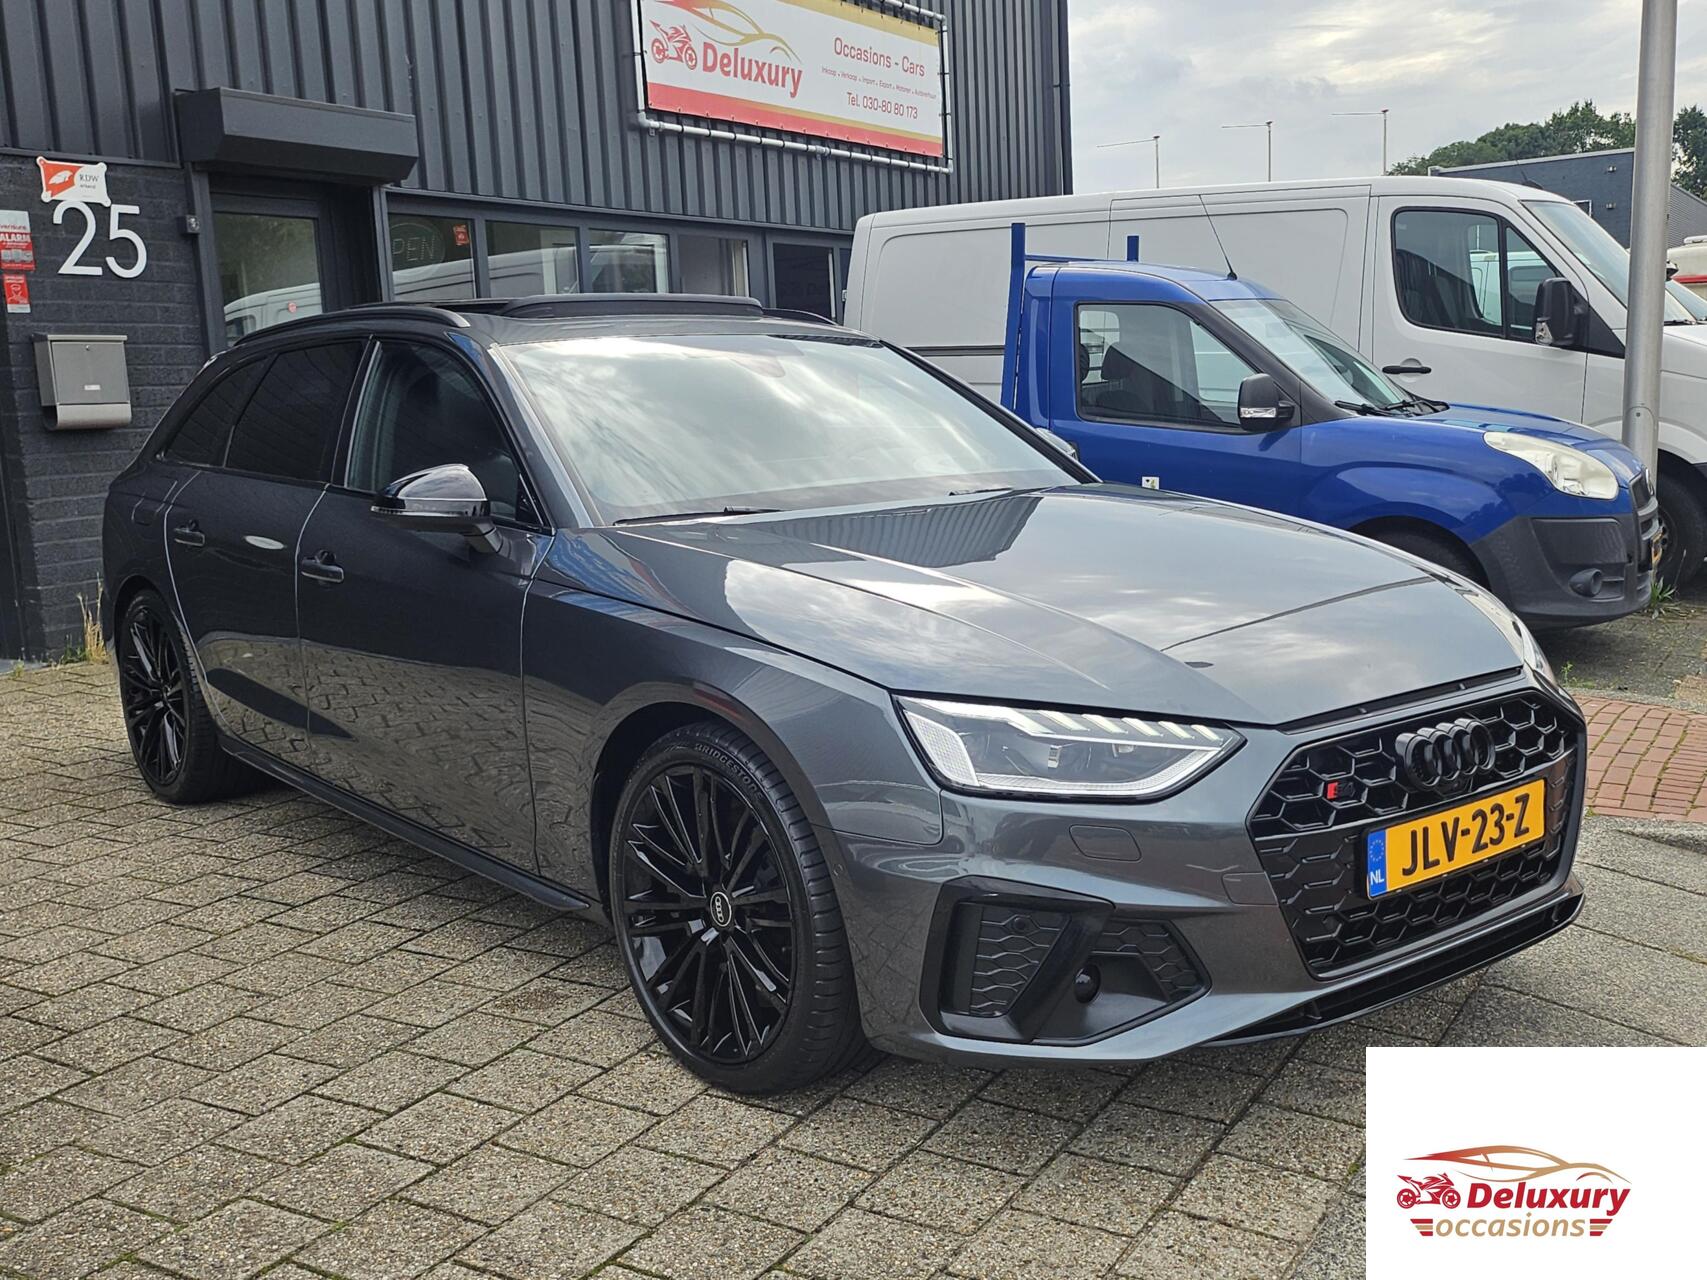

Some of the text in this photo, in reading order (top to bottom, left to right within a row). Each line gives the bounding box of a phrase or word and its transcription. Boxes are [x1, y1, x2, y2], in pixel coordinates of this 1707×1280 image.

[703, 41, 802, 99] Deluxury
[834, 36, 892, 68] Occasions
[902, 56, 925, 78] Cars
[862, 75, 876, 86] Import
[879, 80, 892, 90] Export
[846, 91, 918, 120] Tel. 030-80 80 173
[79, 173, 98, 182] RDW
[53, 201, 147, 279] 25
[391, 235, 435, 262] PEN
[694, 742, 764, 800] BRIDGESTONE
[1401, 792, 1530, 876] JLV-23-Z
[1369, 868, 1385, 886] NL
